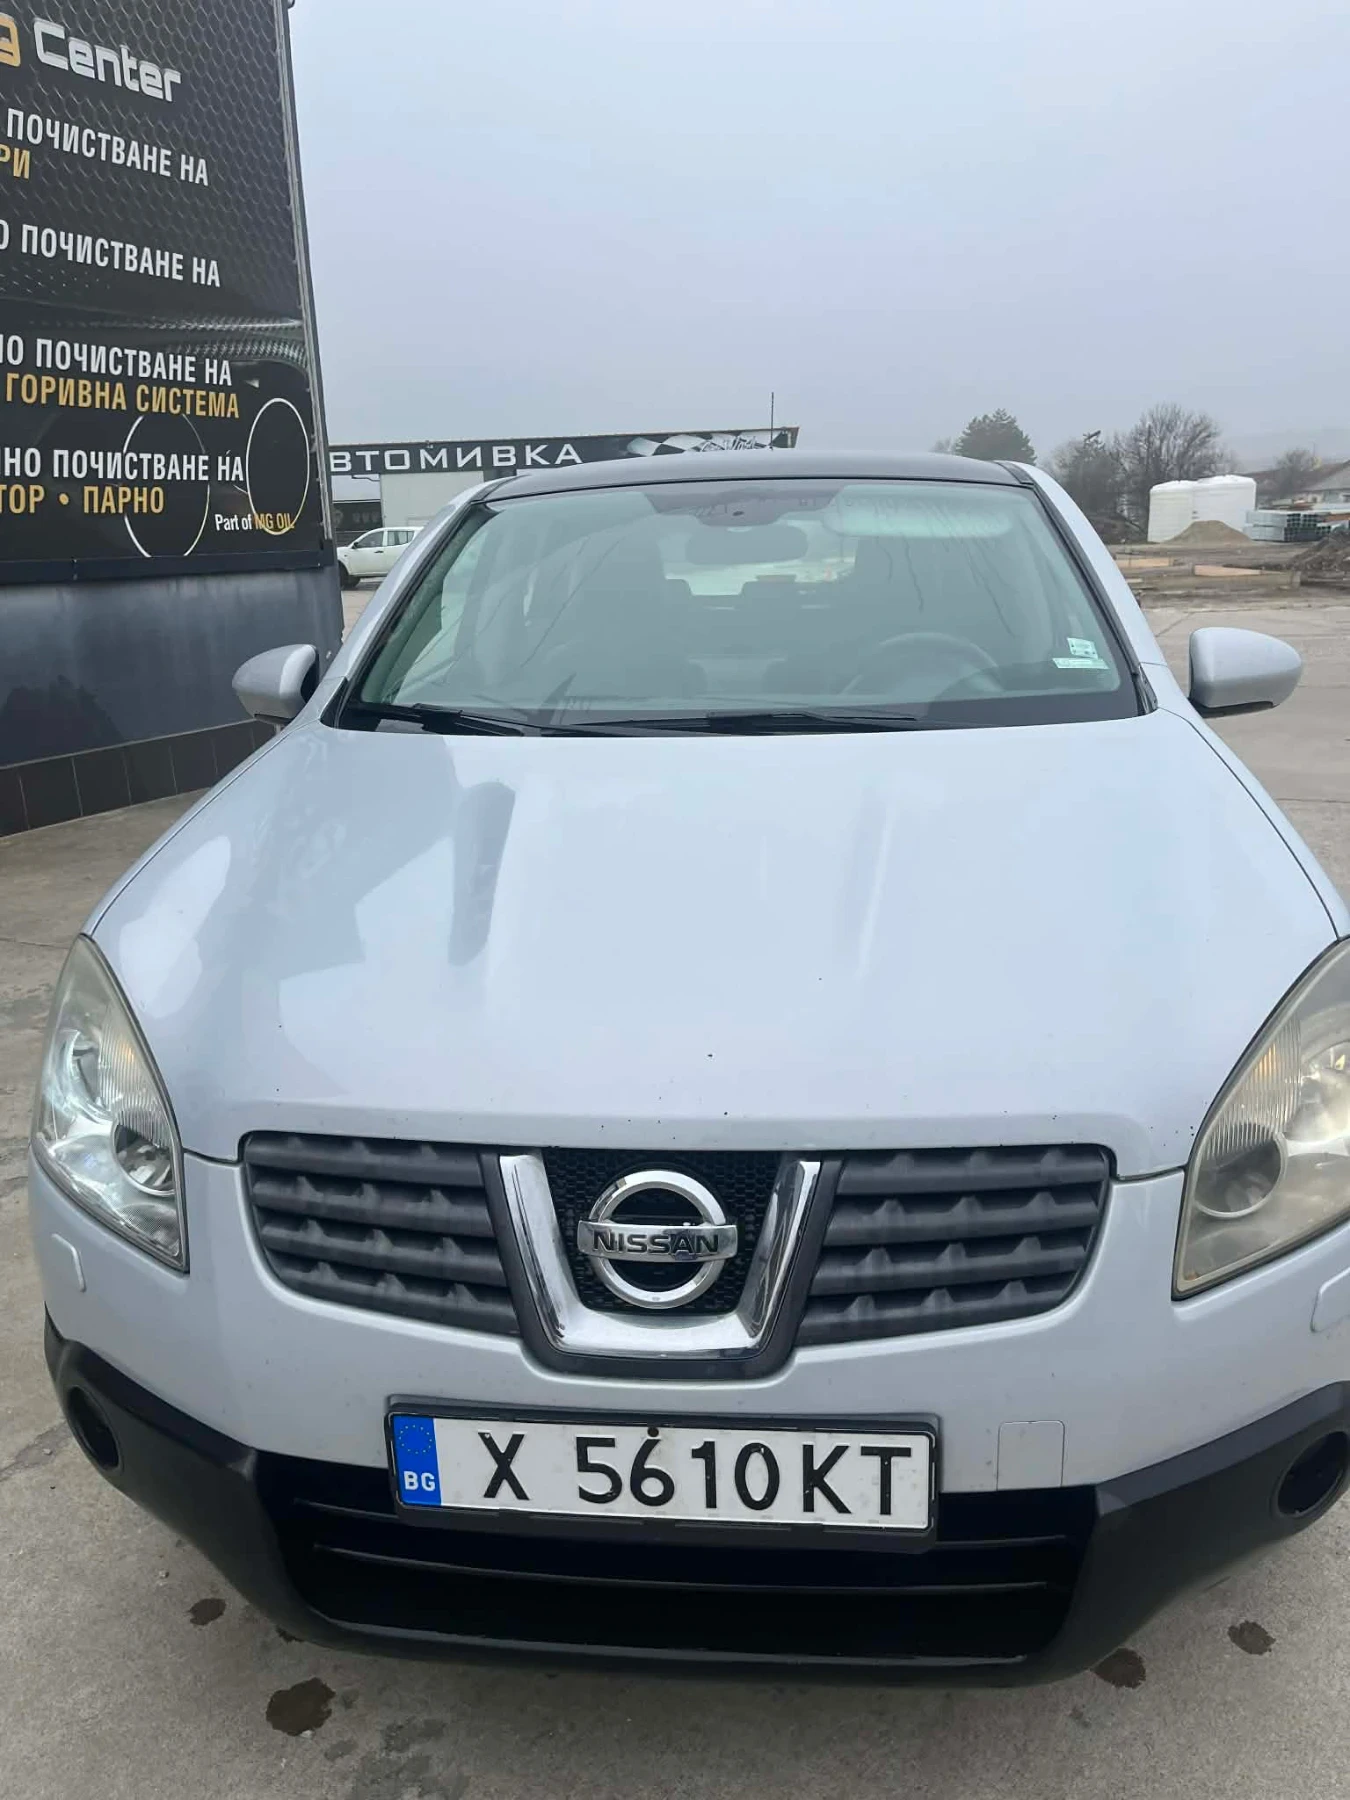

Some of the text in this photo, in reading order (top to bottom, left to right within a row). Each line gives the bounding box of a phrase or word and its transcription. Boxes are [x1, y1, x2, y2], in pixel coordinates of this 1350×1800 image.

[34, 17, 181, 102] Center
[7, 108, 208, 186] ПОЧИСТВАНЕ НА
[22, 224, 183, 281] ПОЧИСТВАНЕ
[192, 257, 220, 287] НА
[0, 334, 232, 386] О ПОЧИСТВАНЕ НА
[6, 373, 240, 418] ГОРИВНА СИСТЕМА
[53, 449, 209, 481] ПОЧИСТВАНЕ
[217, 456, 244, 481] НА
[83, 485, 164, 513] ПАРНО
[215, 513, 294, 531] Part of MG OIL
[593, 1229, 719, 1254] NISSAN
[403, 1471, 436, 1493] BG
